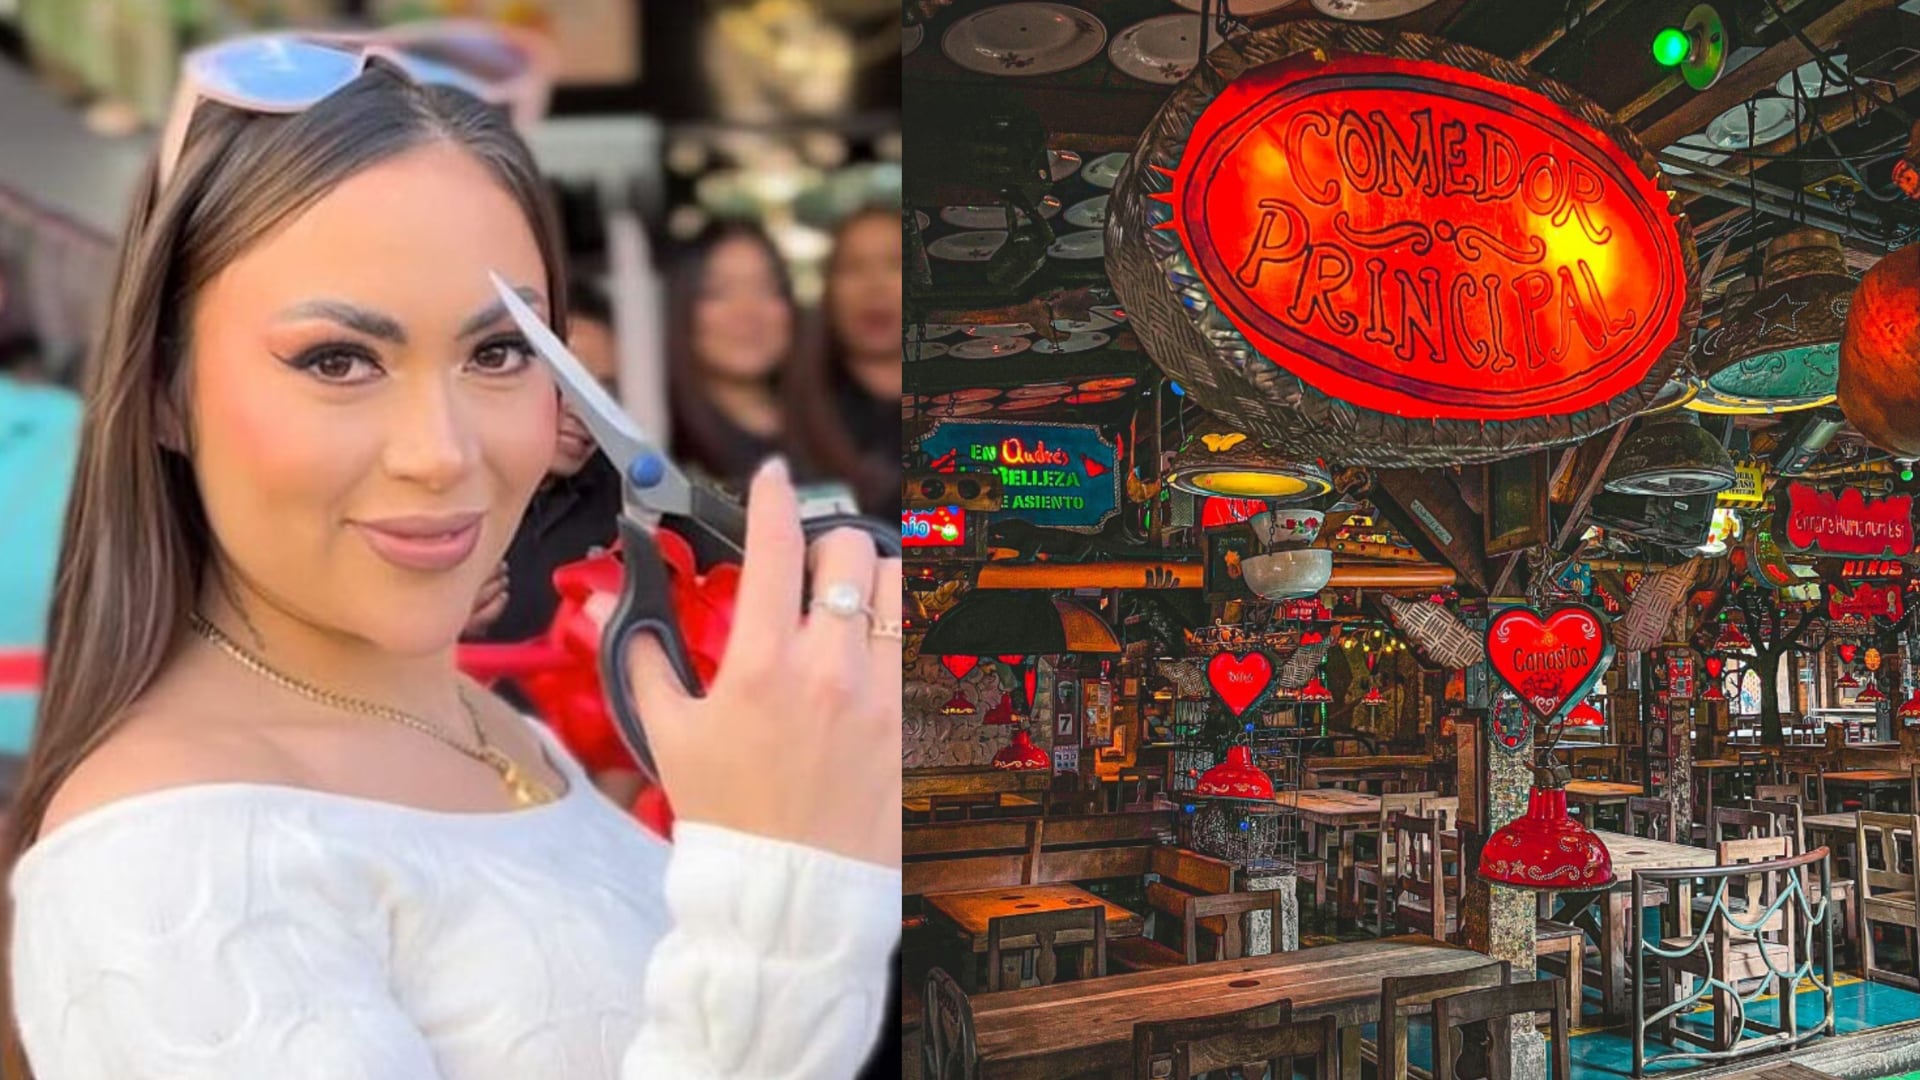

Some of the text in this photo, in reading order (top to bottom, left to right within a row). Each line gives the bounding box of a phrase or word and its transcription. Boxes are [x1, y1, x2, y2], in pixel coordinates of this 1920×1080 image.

[1285, 108, 1611, 244] COMEDOR
[1237, 200, 1636, 372] PRINCIPAL
[970, 444, 997, 460] EN
[992, 466, 1081, 487] BELLEZA
[1011, 495, 1086, 510] ASIENTO
[1513, 644, 1588, 672] Canastos
[1059, 716, 1071, 732] 7
